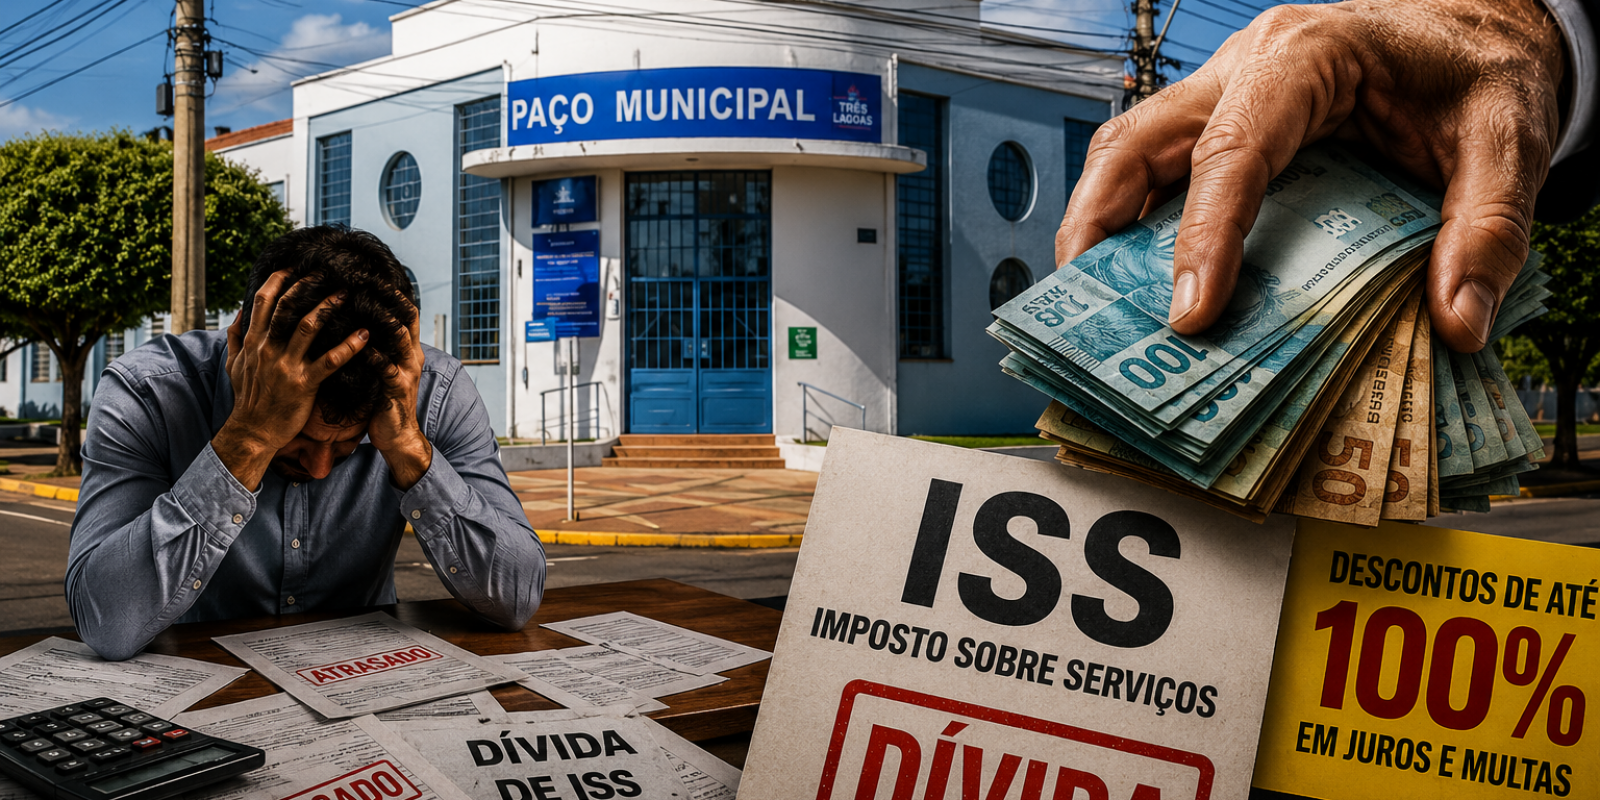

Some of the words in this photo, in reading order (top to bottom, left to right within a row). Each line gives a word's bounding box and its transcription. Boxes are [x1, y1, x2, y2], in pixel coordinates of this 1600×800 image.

[512, 92, 595, 134] PAÇO
[616, 87, 816, 122] MUNICIPAL
[839, 100, 868, 115] TRÊS
[1312, 431, 1374, 505] 50
[901, 478, 1183, 649] ISS
[1329, 550, 1498, 605] DESCONTOS
[1503, 575, 1542, 612] DE
[1545, 578, 1599, 620] ATÉ
[310, 648, 432, 684] ATRASADO
[811, 607, 949, 663] IMPOSTO
[953, 637, 1058, 687] SOBRE
[1063, 659, 1218, 719] SERVIÇOS
[1314, 600, 1586, 747] 100%
[466, 730, 638, 767] DÍVIDA
[854, 720, 1161, 800] DÍV
[1296, 721, 1339, 758] EM
[1342, 730, 1432, 774] JUROS
[1438, 745, 1457, 778] E
[1461, 749, 1573, 798] MULTAS
[495, 775, 562, 800] DE
[567, 770, 642, 800] ISS
